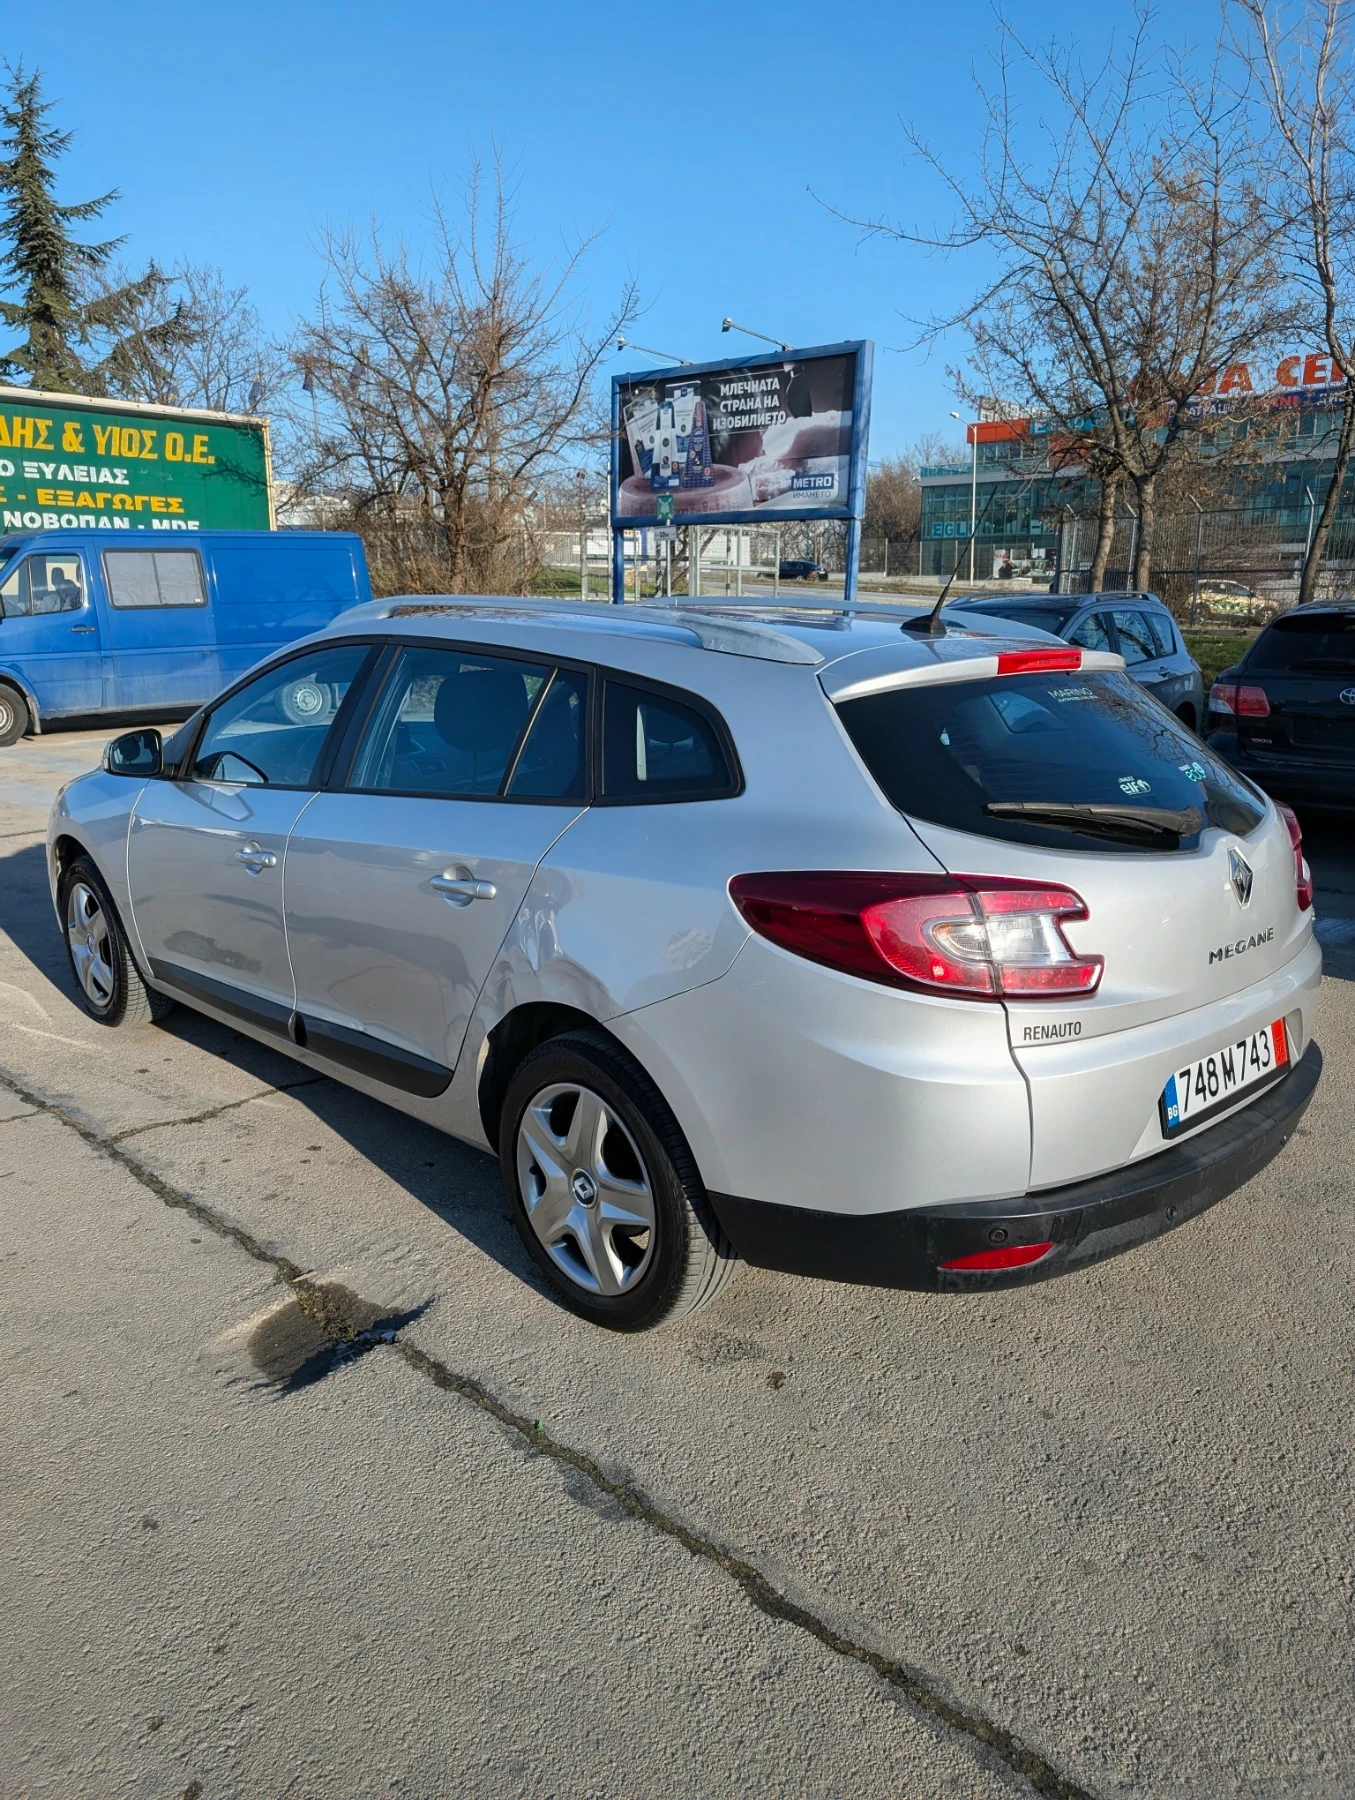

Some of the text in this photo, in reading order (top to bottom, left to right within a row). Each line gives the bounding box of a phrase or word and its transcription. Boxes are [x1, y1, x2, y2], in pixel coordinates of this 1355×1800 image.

[720, 377, 780, 396] МЛЕЧНАТА
[720, 394, 780, 413] СТРАНА НА
[713, 411, 786, 430] ИЗОБИЛИЕТО
[62, 421, 85, 453] &
[92, 424, 158, 459] ΥΙΟΣ
[165, 432, 215, 464] Ο.Ε.
[22, 461, 129, 485] ΞΥΛΕΙΑΣ
[793, 476, 832, 488] METRO
[37, 488, 185, 513] ΕΞΑΓΩΓΕΣ
[792, 491, 819, 499] ИМАМЕ
[3, 510, 130, 529] ΝΟΒΟΠΑΝ
[1048, 687, 1093, 699] MARINO
[1119, 780, 1139, 795] elf
[1208, 927, 1275, 965] MEGANE
[1023, 1021, 1082, 1041] RENAUTO
[1167, 1105, 1179, 1121] BG
